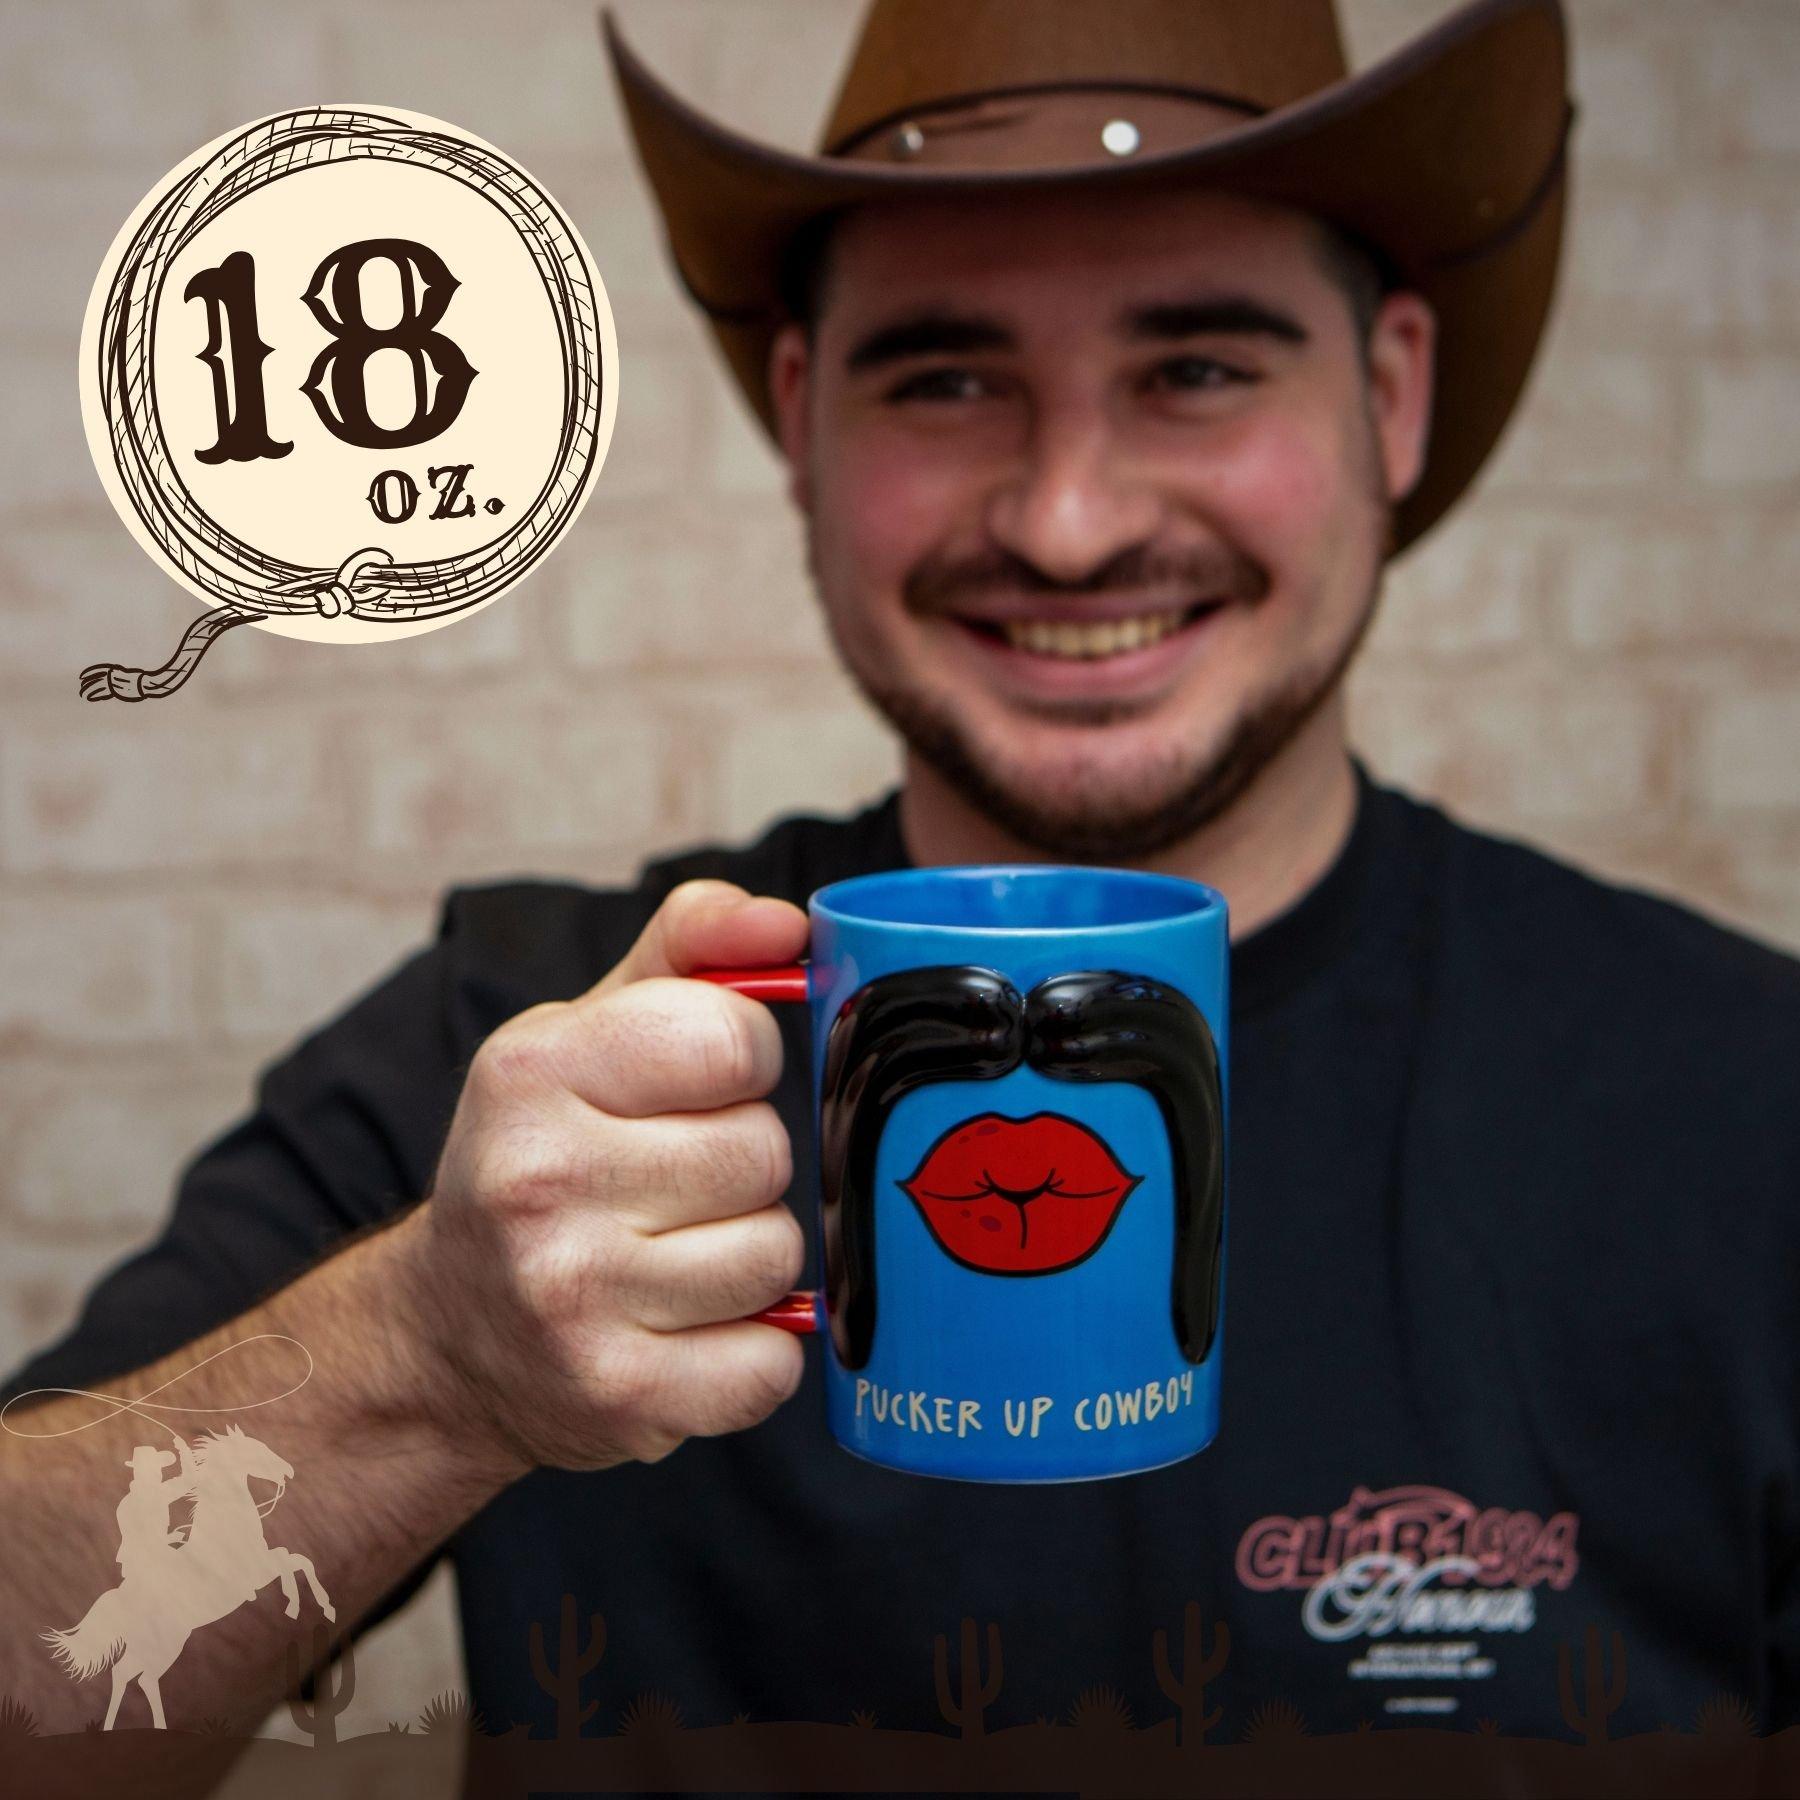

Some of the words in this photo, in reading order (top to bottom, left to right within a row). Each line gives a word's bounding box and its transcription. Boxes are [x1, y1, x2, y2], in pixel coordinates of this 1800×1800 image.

[856, 1378, 983, 1438] PUCKER
[1004, 1397, 1054, 1438] UP
[1074, 1370, 1194, 1431] COWBOY
